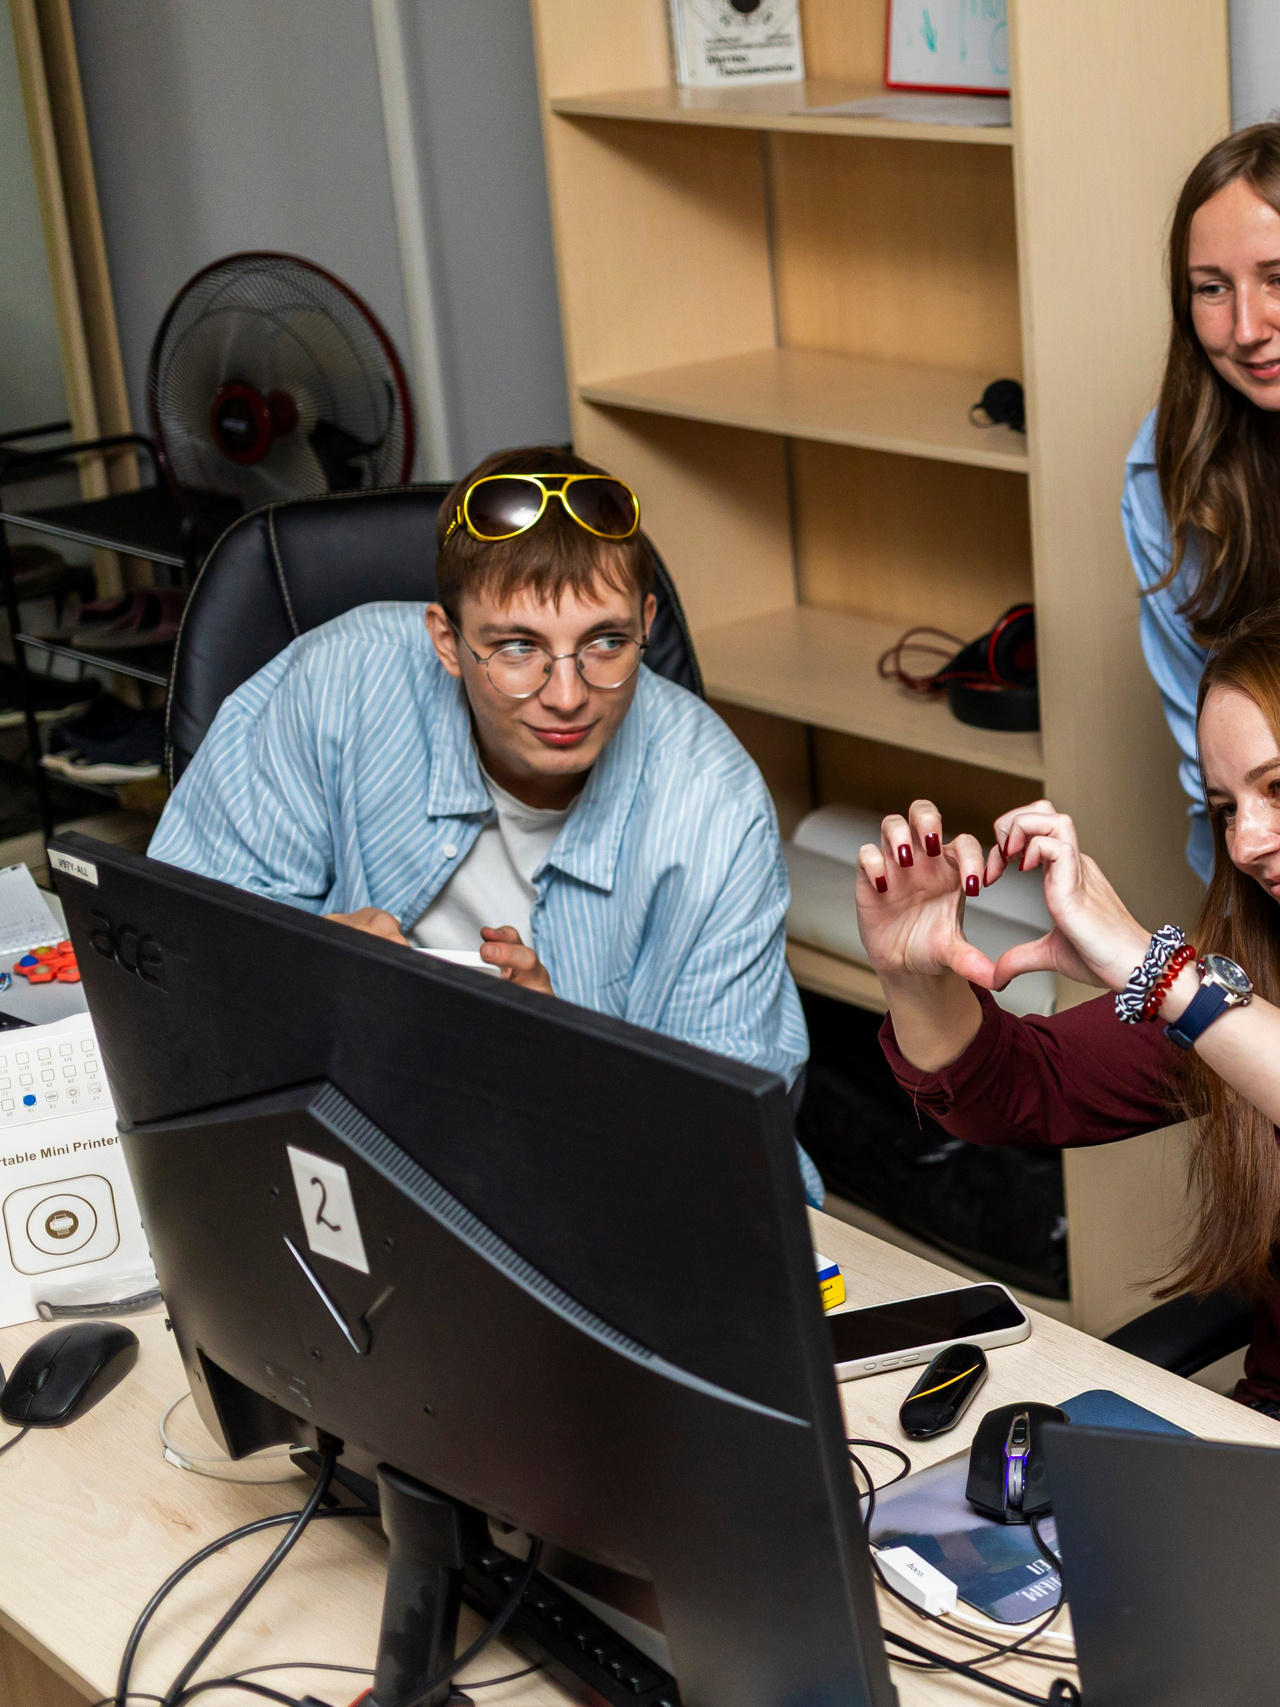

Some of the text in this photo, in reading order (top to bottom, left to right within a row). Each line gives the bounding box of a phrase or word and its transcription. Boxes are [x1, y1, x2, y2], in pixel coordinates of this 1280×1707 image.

[0, 1136, 120, 1167] table Mini Printer
[310, 1177, 341, 1232] 2
